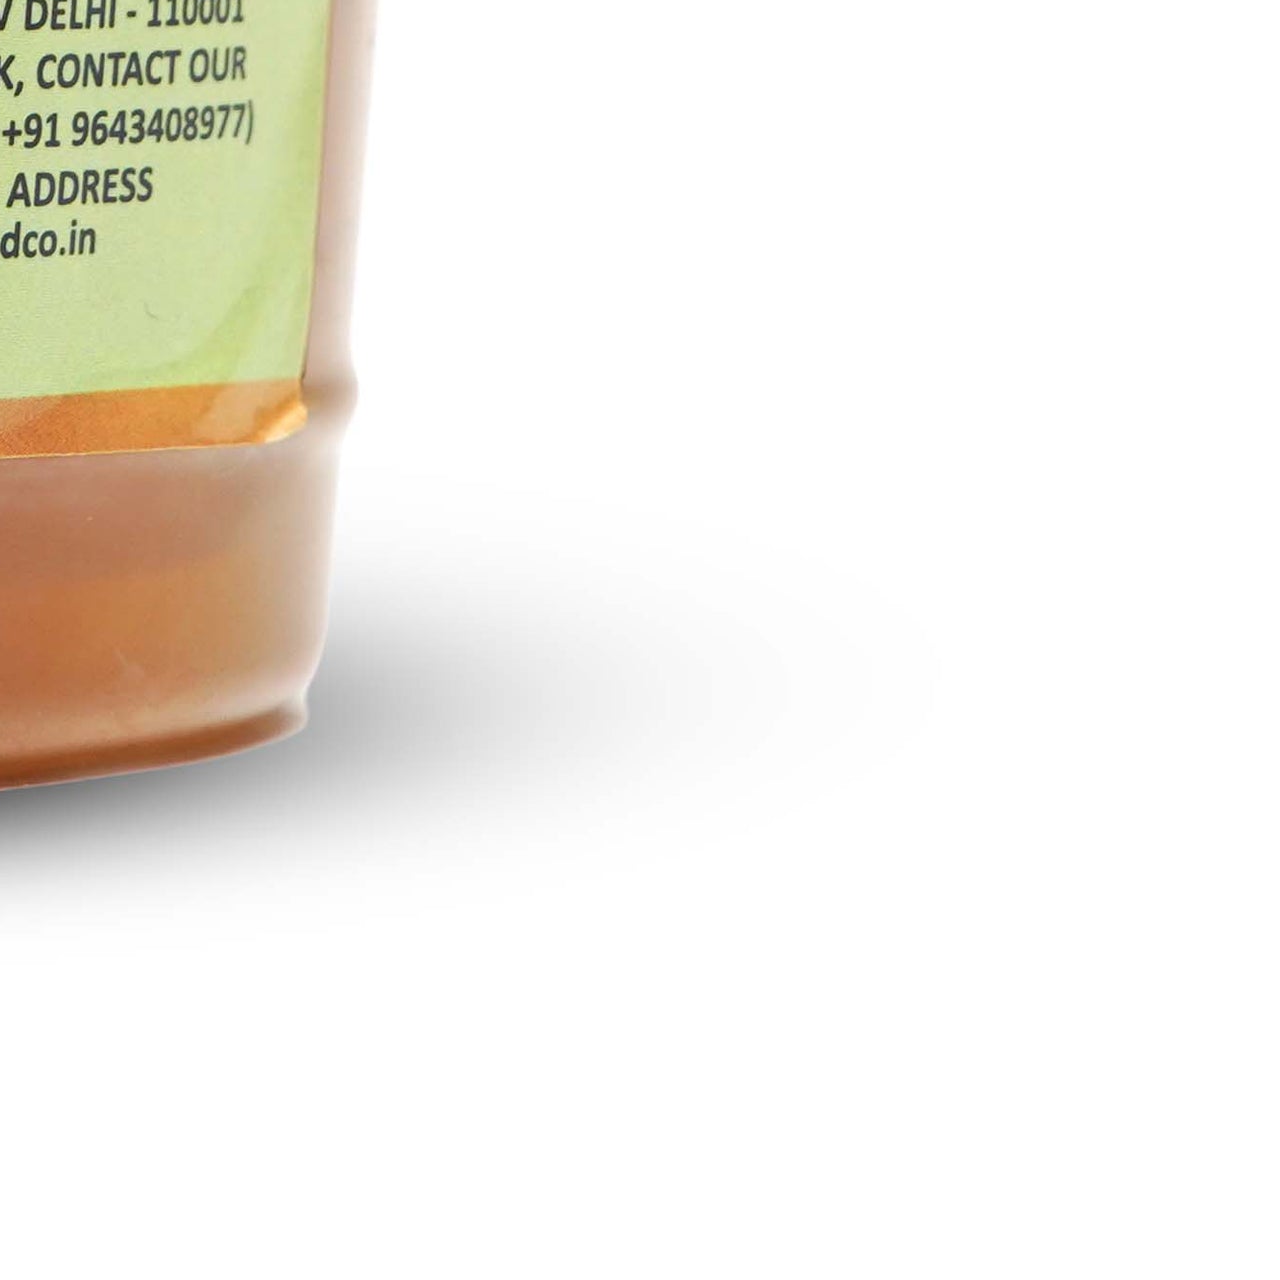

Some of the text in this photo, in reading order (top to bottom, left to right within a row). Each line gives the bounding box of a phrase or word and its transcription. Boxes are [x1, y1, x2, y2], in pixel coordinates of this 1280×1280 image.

[36, 50, 182, 90] CONTACT
[189, 47, 245, 83] OUR
[2, 112, 61, 149] +91
[70, 99, 254, 147] 9643408977)
[6, 166, 153, 208] ADDRESS
